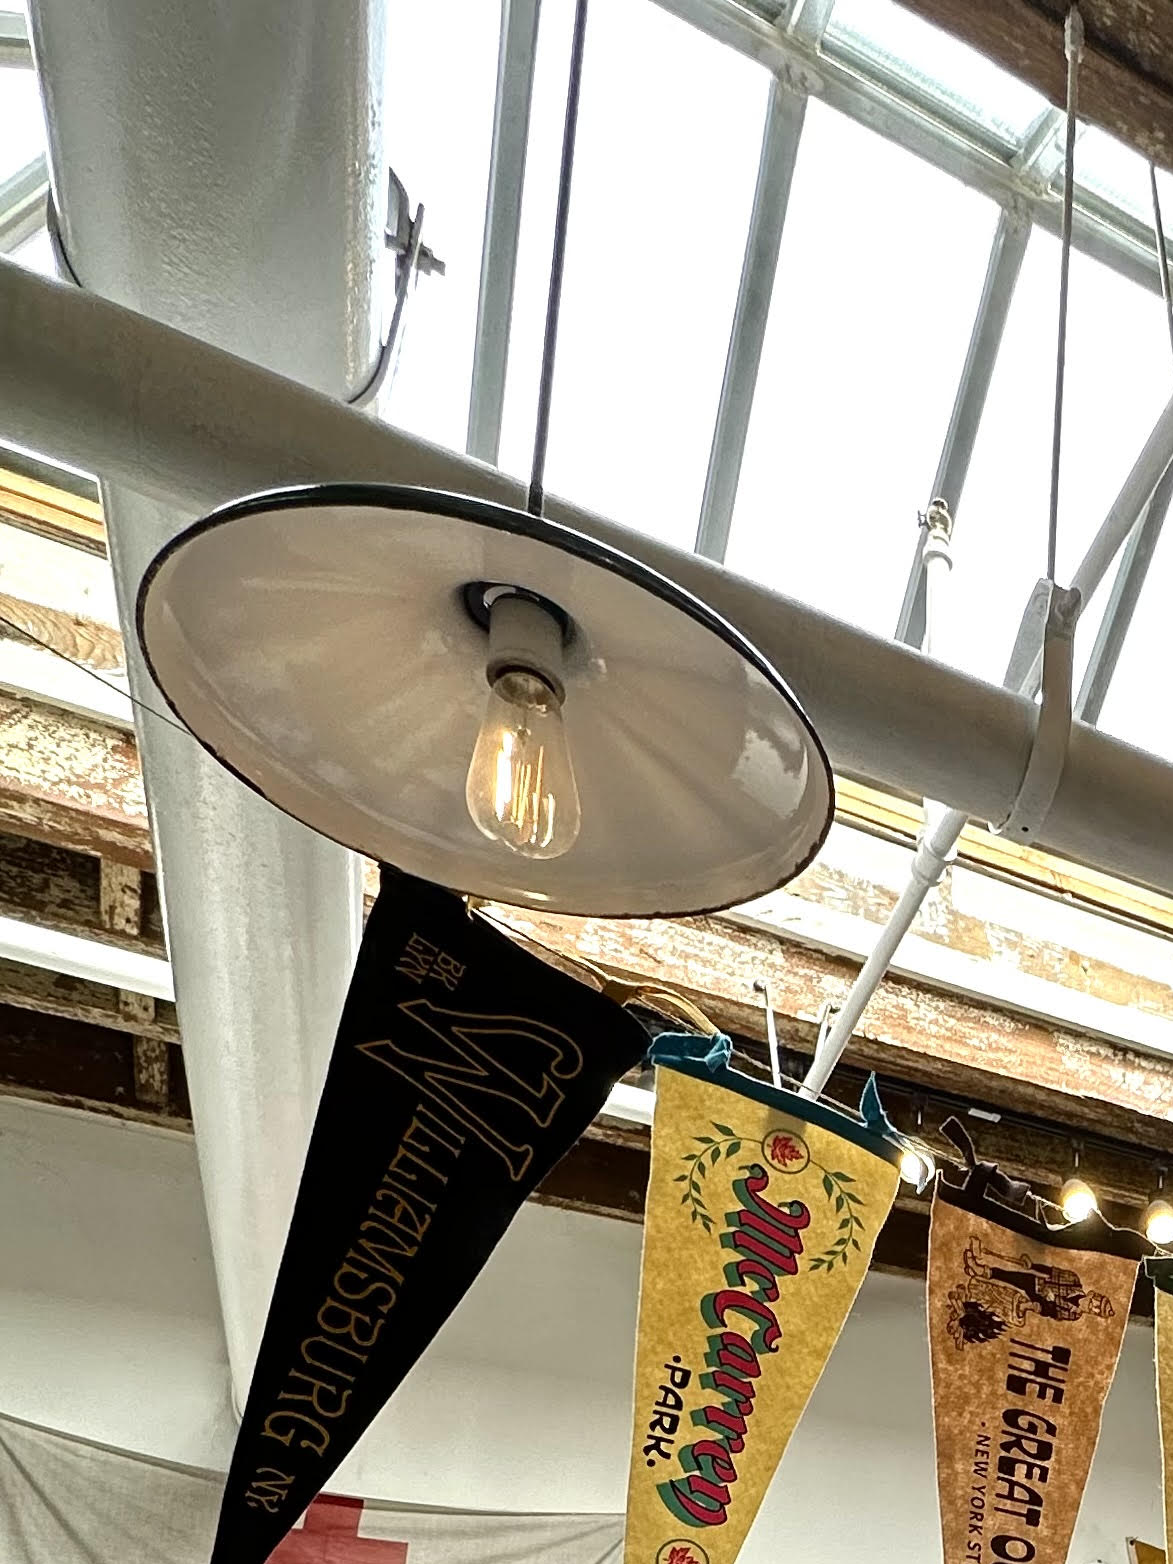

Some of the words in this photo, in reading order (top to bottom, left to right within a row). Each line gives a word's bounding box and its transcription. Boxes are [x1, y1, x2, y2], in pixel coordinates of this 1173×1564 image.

[1005, 1338, 1073, 1404] THE
[974, 1433, 991, 1477] NEW
[995, 1408, 1056, 1528] GREAT
[967, 1483, 985, 1535] YORK
